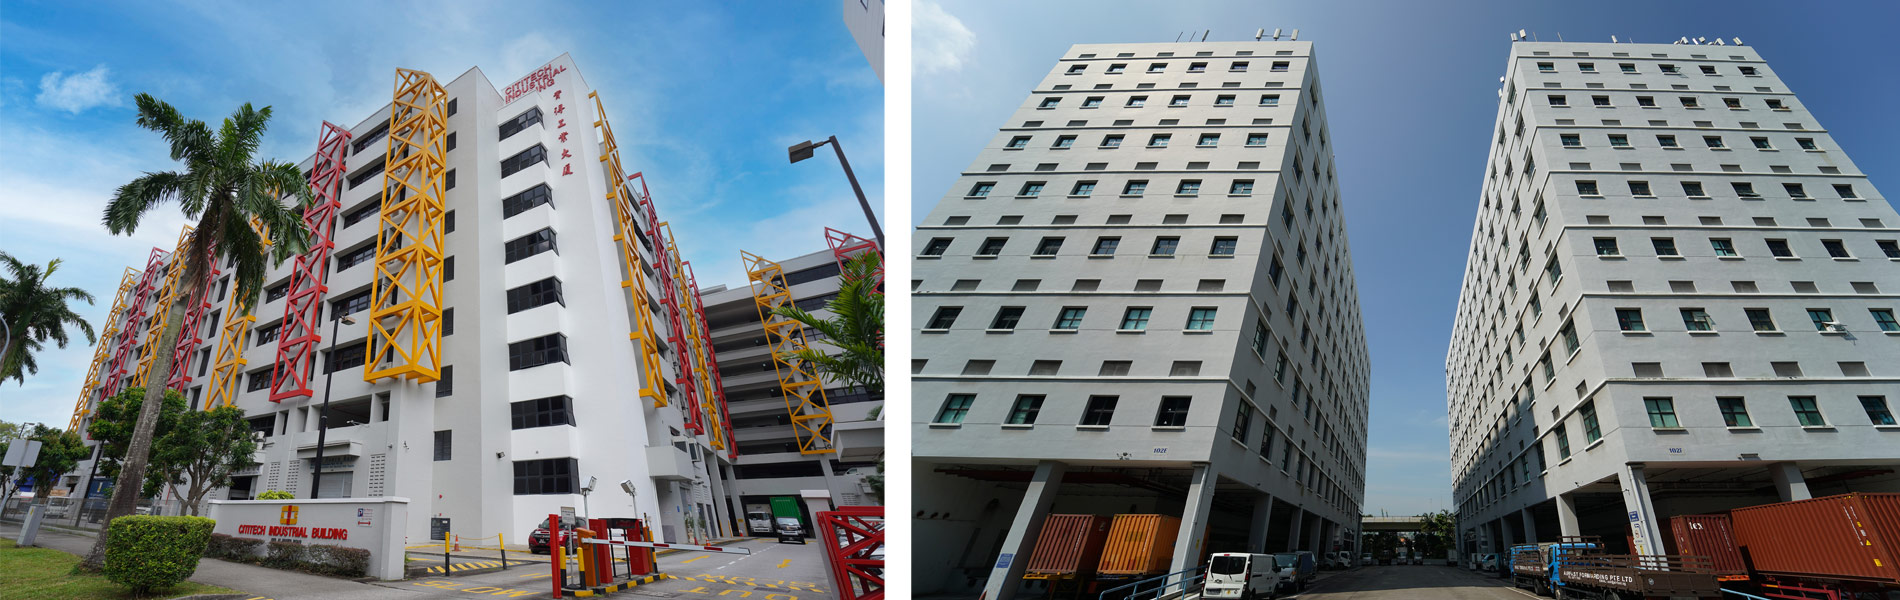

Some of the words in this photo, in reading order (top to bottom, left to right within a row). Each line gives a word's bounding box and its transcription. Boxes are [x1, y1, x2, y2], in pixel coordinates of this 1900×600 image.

[504, 63, 552, 96] CITITECH
[504, 64, 567, 104] INDUSTRIAL
[238, 524, 266, 536] CITITECH
[268, 526, 308, 538] INDUSTRIAL
[311, 527, 348, 540] BUILDING
[1579, 571, 1609, 580] FORWARDING
[1621, 575, 1633, 583] LTD
